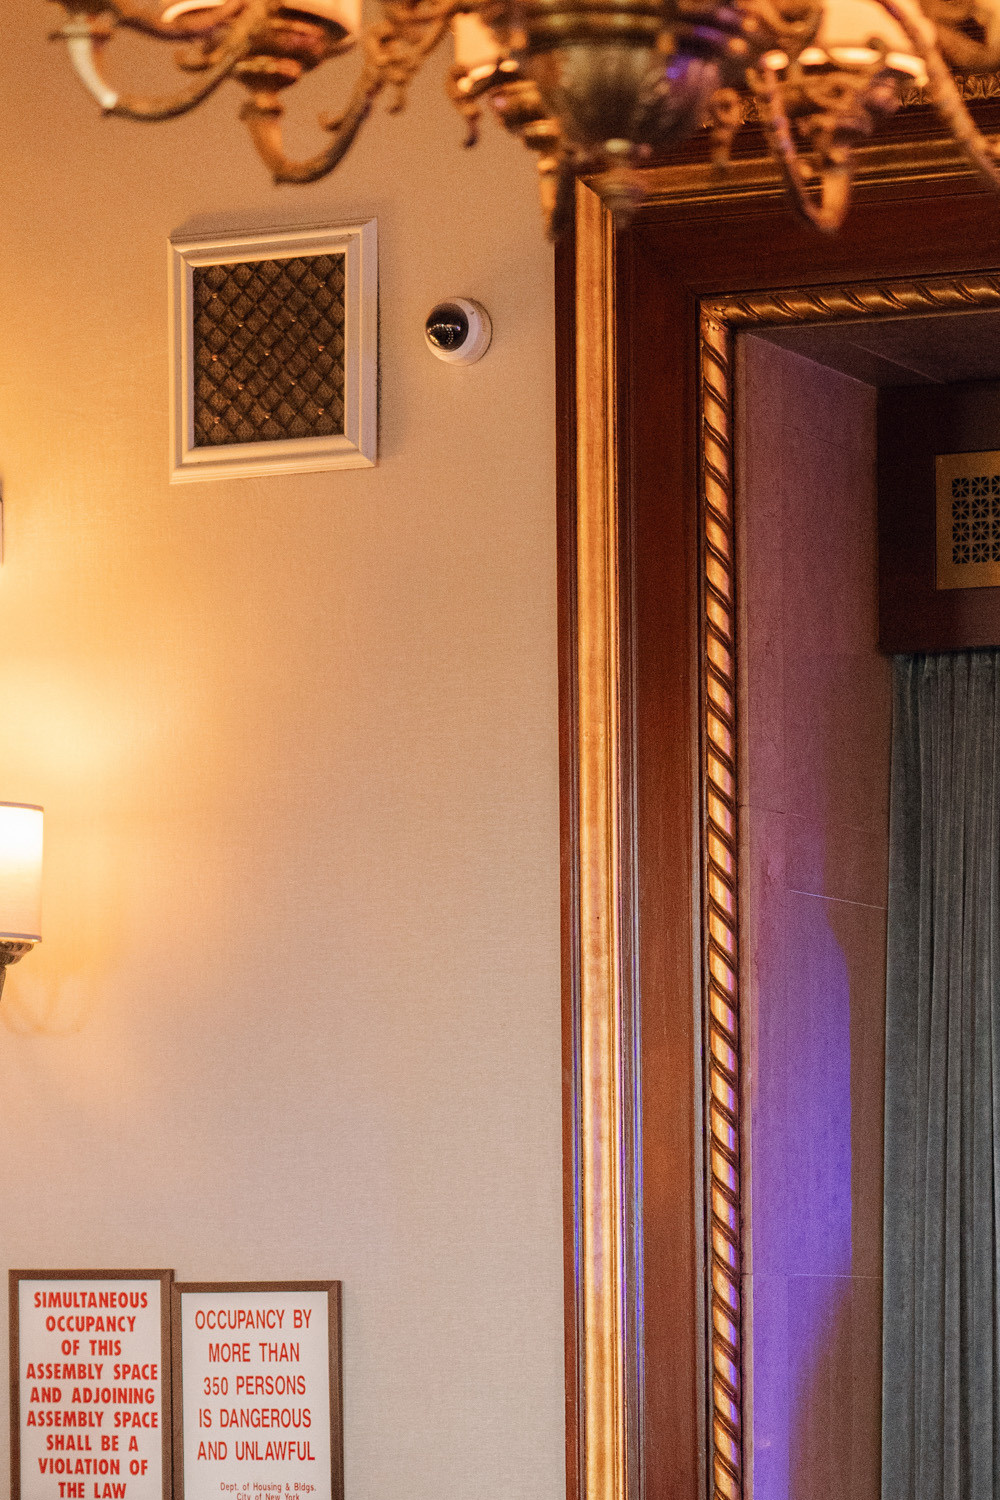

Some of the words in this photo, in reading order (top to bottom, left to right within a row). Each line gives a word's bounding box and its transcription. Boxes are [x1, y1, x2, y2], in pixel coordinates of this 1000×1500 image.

[33, 1291, 148, 1309] SIMULTANEOUS
[46, 1315, 136, 1332] OCCUPANCY
[195, 1309, 285, 1330] OCCUPANCY
[293, 1309, 312, 1328] BY
[61, 1339, 80, 1356] OF
[89, 1339, 121, 1356] THIS
[209, 1342, 251, 1363] MORE
[258, 1342, 299, 1362] THAN
[26, 1363, 104, 1380] ASSEMBLY
[113, 1363, 157, 1381] SPACE
[204, 1377, 228, 1395] 350
[236, 1375, 306, 1395] PERSONS
[30, 1387, 62, 1404] AND
[72, 1387, 155, 1405] ADJOINING
[27, 1410, 104, 1428] ASSEMBLY
[114, 1411, 158, 1428] SPACE
[199, 1408, 212, 1428] IS
[220, 1408, 311, 1428] DANGEROUS
[46, 1434, 92, 1451] SHALL
[101, 1434, 119, 1452] BE
[128, 1435, 139, 1452] A
[197, 1441, 227, 1460] AND
[235, 1441, 315, 1461] UNLAWFUL
[38, 1458, 120, 1475] VIOLATION
[129, 1459, 148, 1475] OF
[58, 1482, 85, 1499] THE
[94, 1482, 126, 1499] LAW
[242, 1482, 250, 1491] of
[253, 1482, 282, 1494] Housing
[285, 1482, 291, 1492] &
